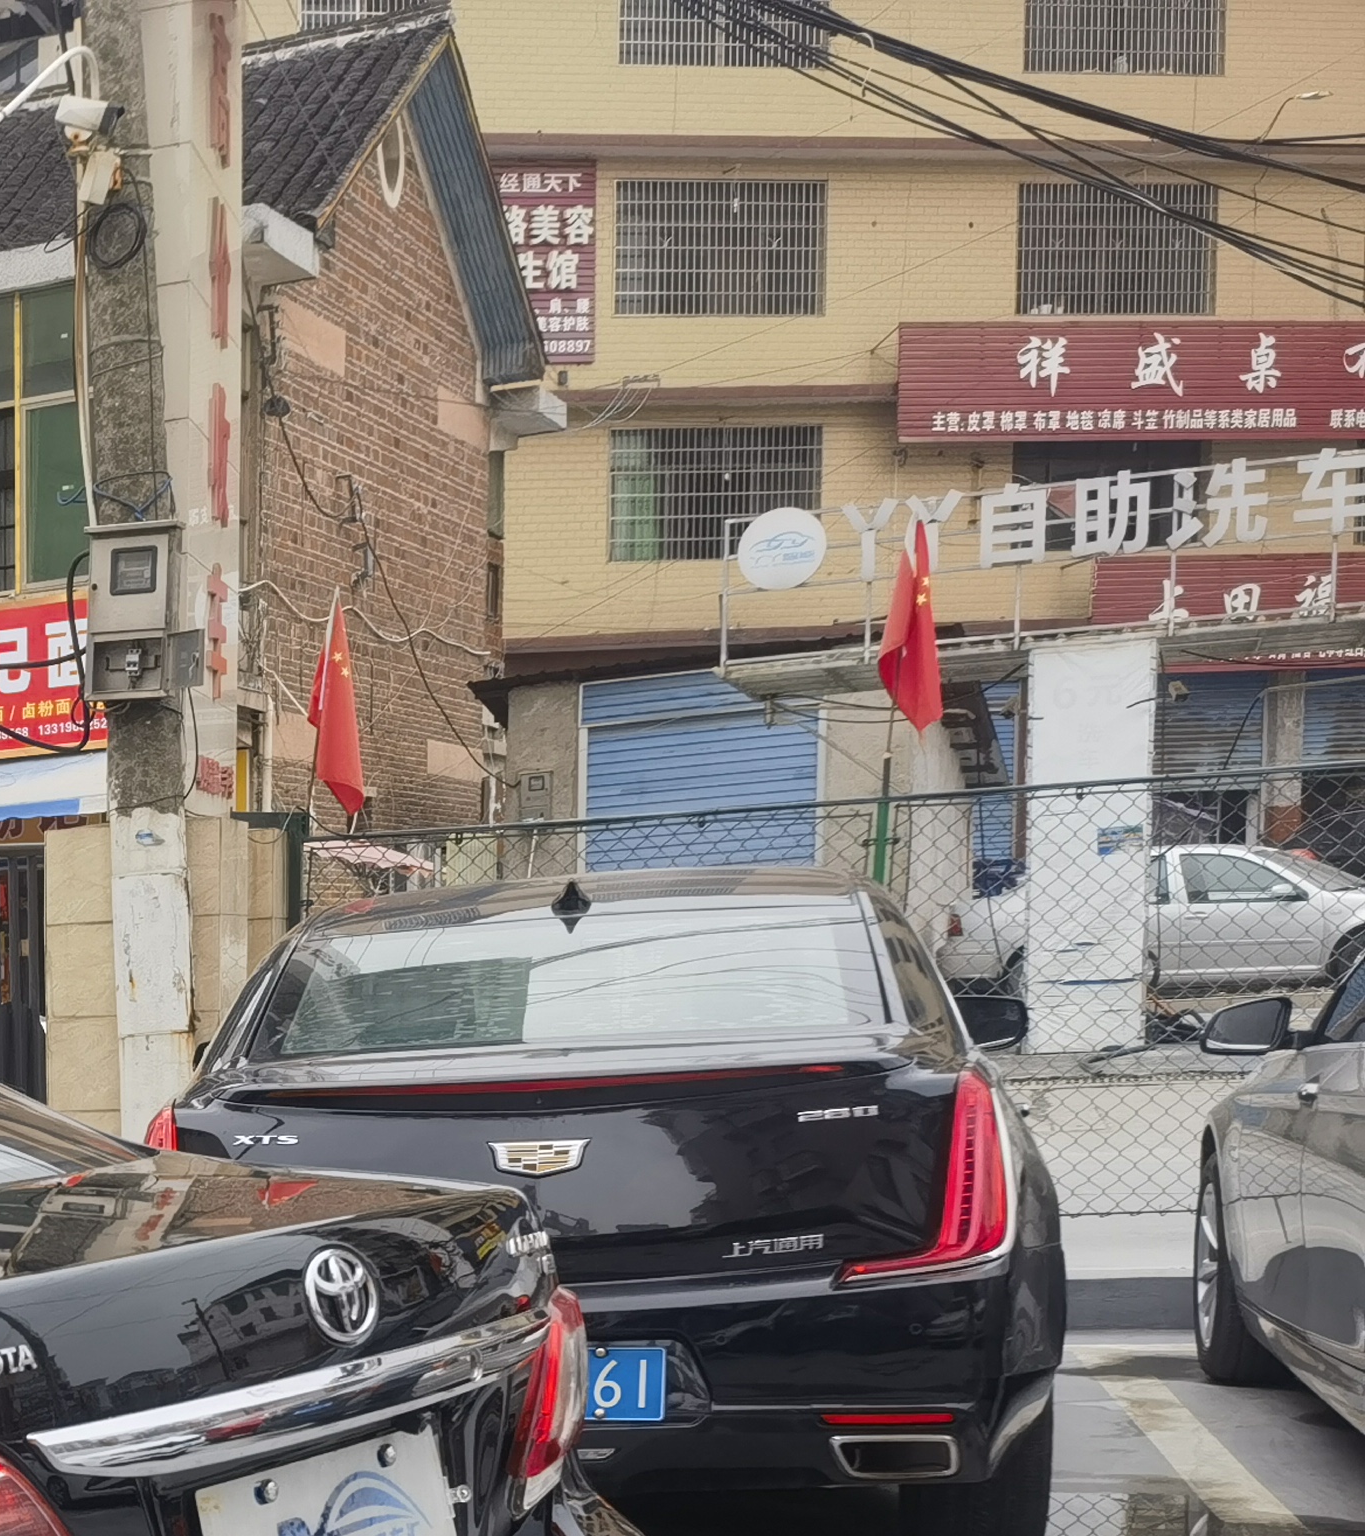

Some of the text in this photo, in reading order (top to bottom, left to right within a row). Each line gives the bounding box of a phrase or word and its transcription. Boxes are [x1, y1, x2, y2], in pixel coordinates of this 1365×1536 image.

[500, 173, 582, 193] 经通天下
[232, 1134, 299, 1146] XTS
[722, 1233, 825, 1259] 上汽通用
[593, 1358, 648, 1409] 61
